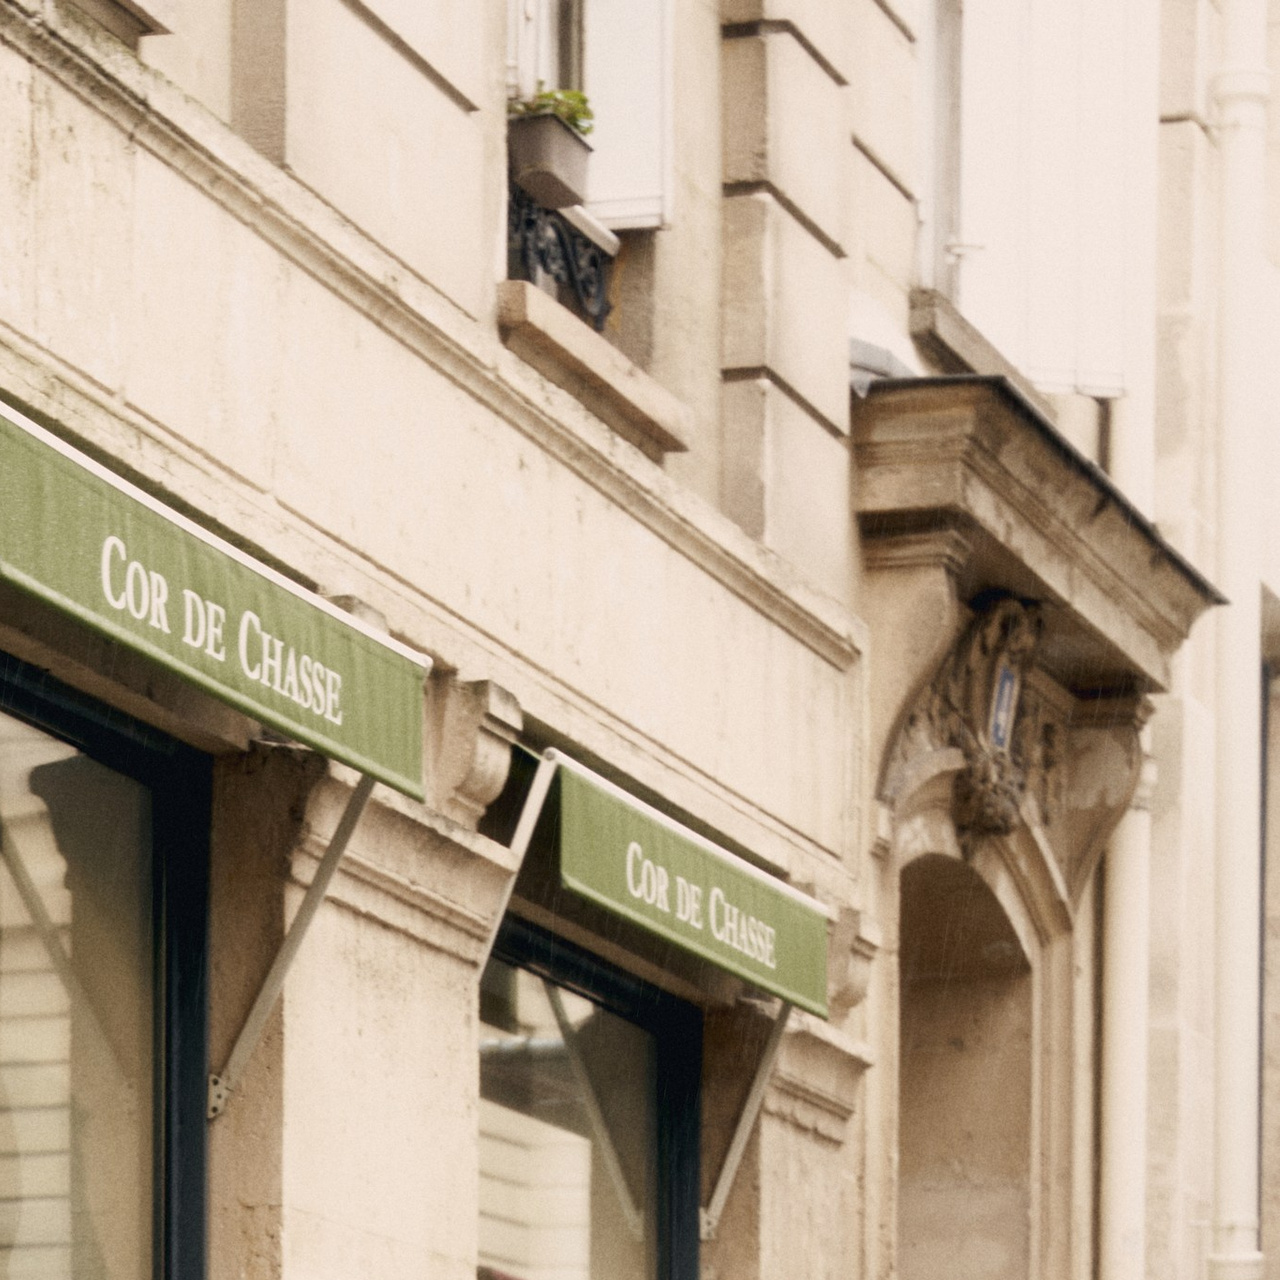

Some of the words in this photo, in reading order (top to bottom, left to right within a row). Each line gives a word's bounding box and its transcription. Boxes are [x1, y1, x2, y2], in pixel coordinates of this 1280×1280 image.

[101, 535, 171, 634] COR
[182, 588, 226, 662] DE
[238, 610, 343, 726] CHASSE
[626, 841, 670, 913] COR
[676, 876, 703, 930] DE
[709, 887, 776, 970] CHASSE
